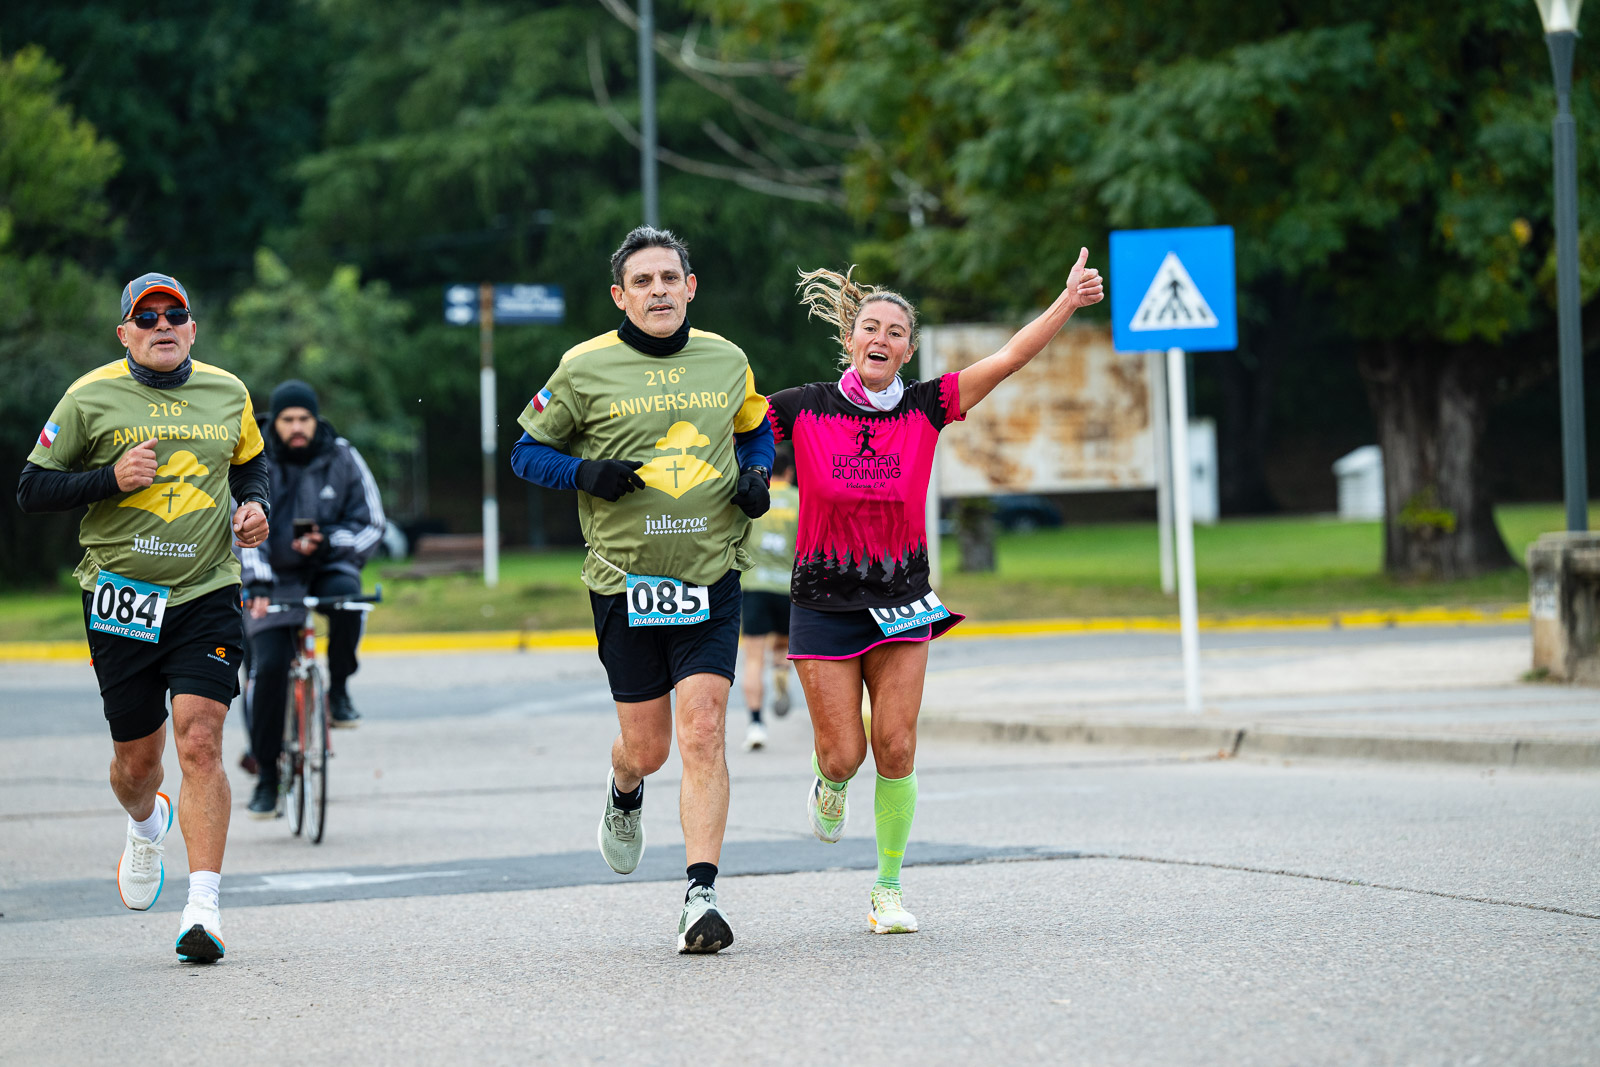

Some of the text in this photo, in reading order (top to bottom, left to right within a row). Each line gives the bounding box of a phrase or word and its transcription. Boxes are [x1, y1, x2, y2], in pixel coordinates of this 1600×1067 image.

[644, 366, 686, 387] 216°
[147, 400, 189, 418] 216°
[609, 391, 729, 419] ANIVERSARIO
[113, 423, 229, 446] ANIVERSARIO
[833, 455, 900, 468] WOMAN
[832, 467, 901, 480] RUNNING
[643, 514, 708, 535] julicroc
[131, 533, 198, 553] julicroc
[97, 582, 159, 629] 084
[632, 580, 701, 615] 085
[633, 614, 706, 625] DIAMANTE CORRE
[886, 611, 945, 634] DIAMANTE CORRE
[93, 621, 156, 641] DIAMANTE CORRE
